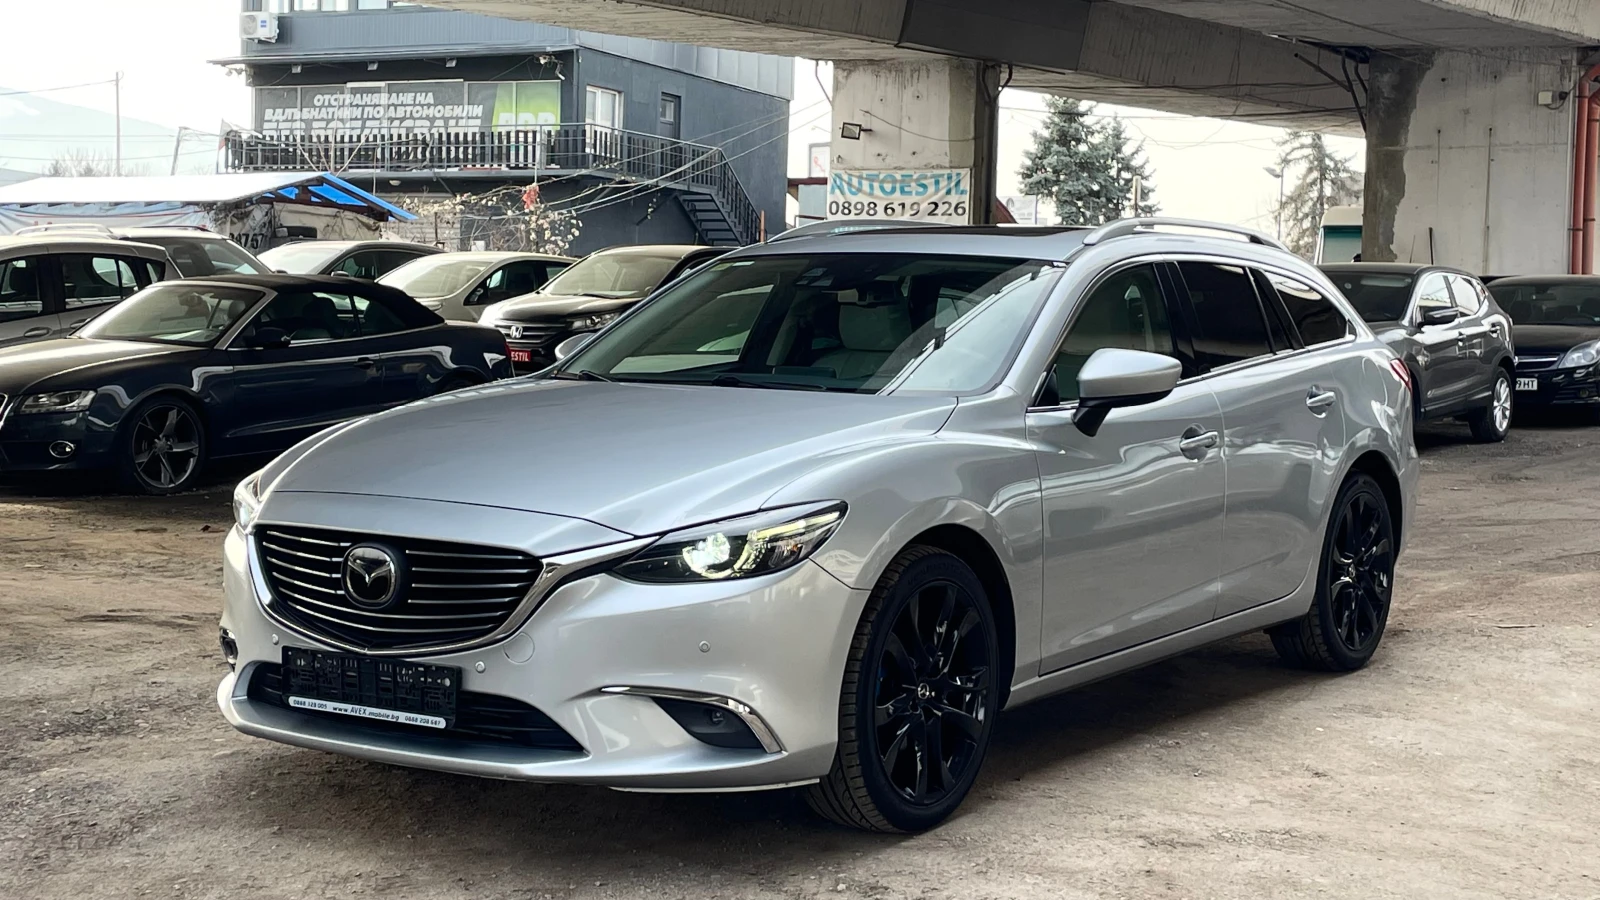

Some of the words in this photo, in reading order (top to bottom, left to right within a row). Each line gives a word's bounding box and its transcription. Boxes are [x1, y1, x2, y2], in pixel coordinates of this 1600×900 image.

[313, 92, 414, 106] ОТСТРАНЯВАНЕ
[415, 92, 434, 104] НА
[264, 106, 362, 121] ВДЛЪБНАТИНИ
[363, 105, 384, 118] ПО
[387, 104, 483, 118] АВТОМОБИЛИ
[830, 172, 968, 196] AUTOESTIL
[829, 200, 878, 216] 0898
[884, 202, 920, 216] 619
[927, 201, 966, 216] 226
